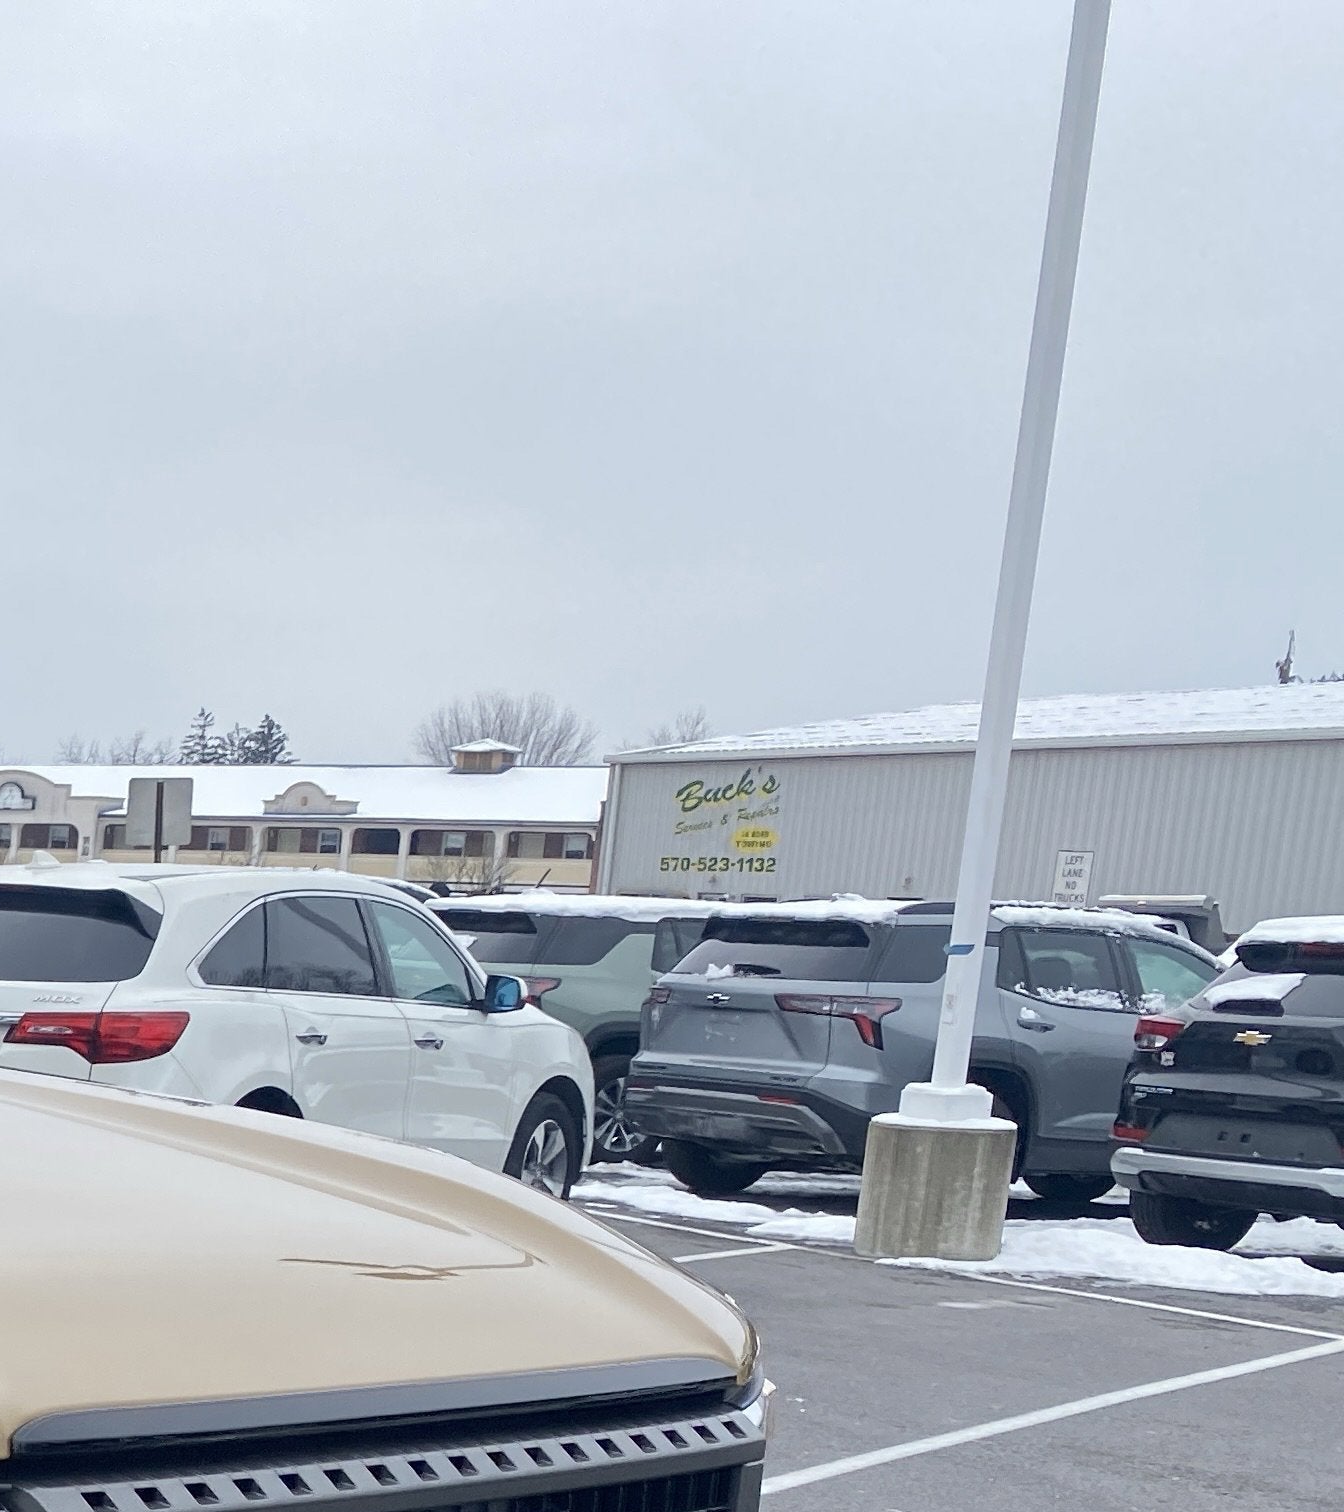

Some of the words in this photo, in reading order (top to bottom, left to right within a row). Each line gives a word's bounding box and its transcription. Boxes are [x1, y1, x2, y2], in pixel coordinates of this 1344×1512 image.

[675, 766, 780, 812] Buck's
[660, 857, 777, 872] 570-523-1132
[1065, 855, 1084, 865] LEFT
[1062, 868, 1083, 878] LANE
[1065, 880, 1077, 890] NO
